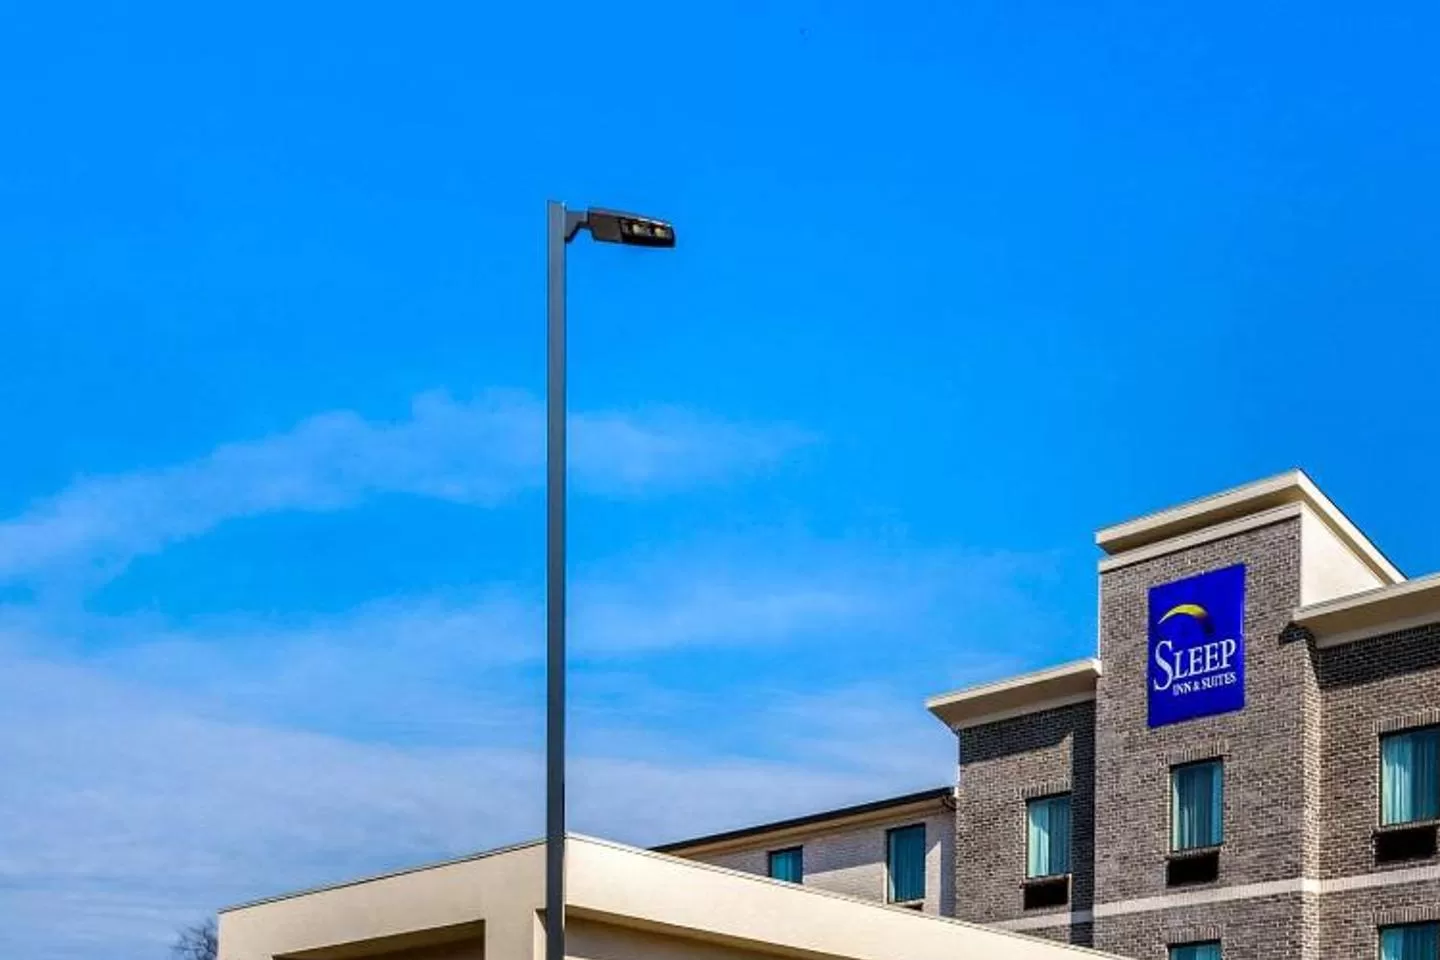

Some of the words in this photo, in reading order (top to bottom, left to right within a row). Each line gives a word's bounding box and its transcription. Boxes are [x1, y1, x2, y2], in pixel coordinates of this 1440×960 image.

[1153, 639, 1237, 691] SLEEP
[1172, 681, 1192, 696] INN
[1193, 681, 1201, 692] &
[1201, 672, 1237, 690] SUITES
